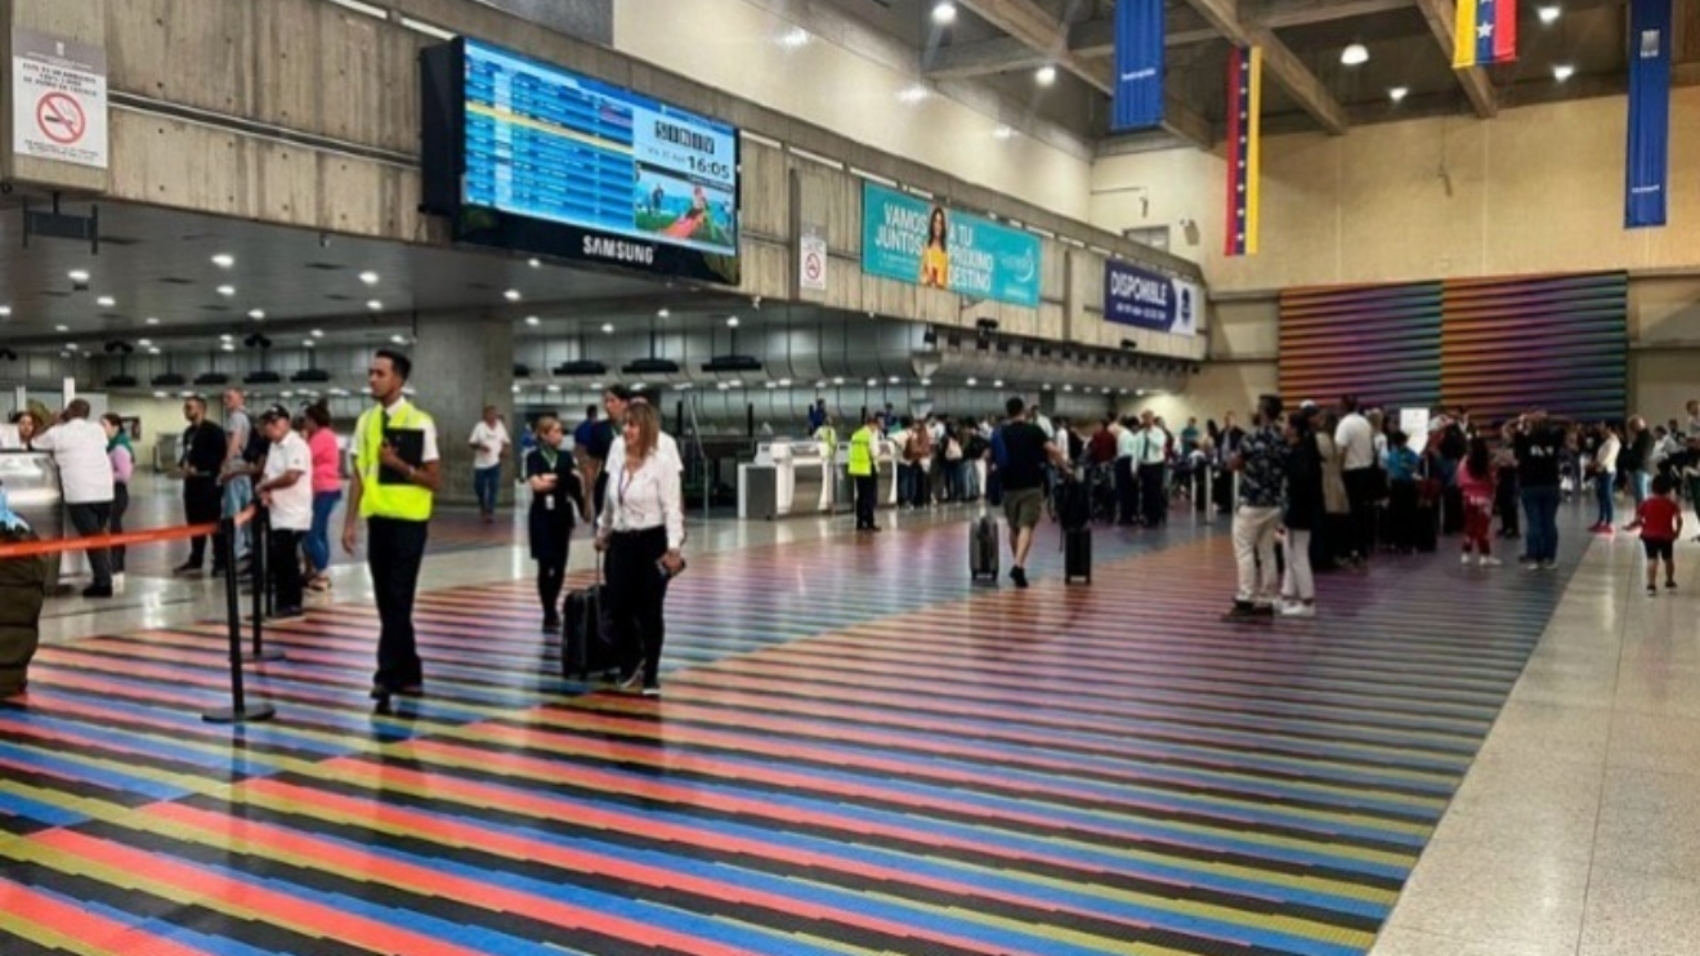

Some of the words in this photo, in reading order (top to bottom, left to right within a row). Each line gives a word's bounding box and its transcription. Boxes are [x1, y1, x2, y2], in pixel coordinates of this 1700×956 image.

[688, 155, 730, 180] 16:05
[884, 202, 928, 236] VAMOS
[582, 235, 654, 264] SAMSUNG
[875, 225, 923, 256] JUNTOS
[959, 224, 973, 247] TU
[947, 265, 992, 293] DESTINO
[1110, 271, 1167, 307] DISPONIBLE
